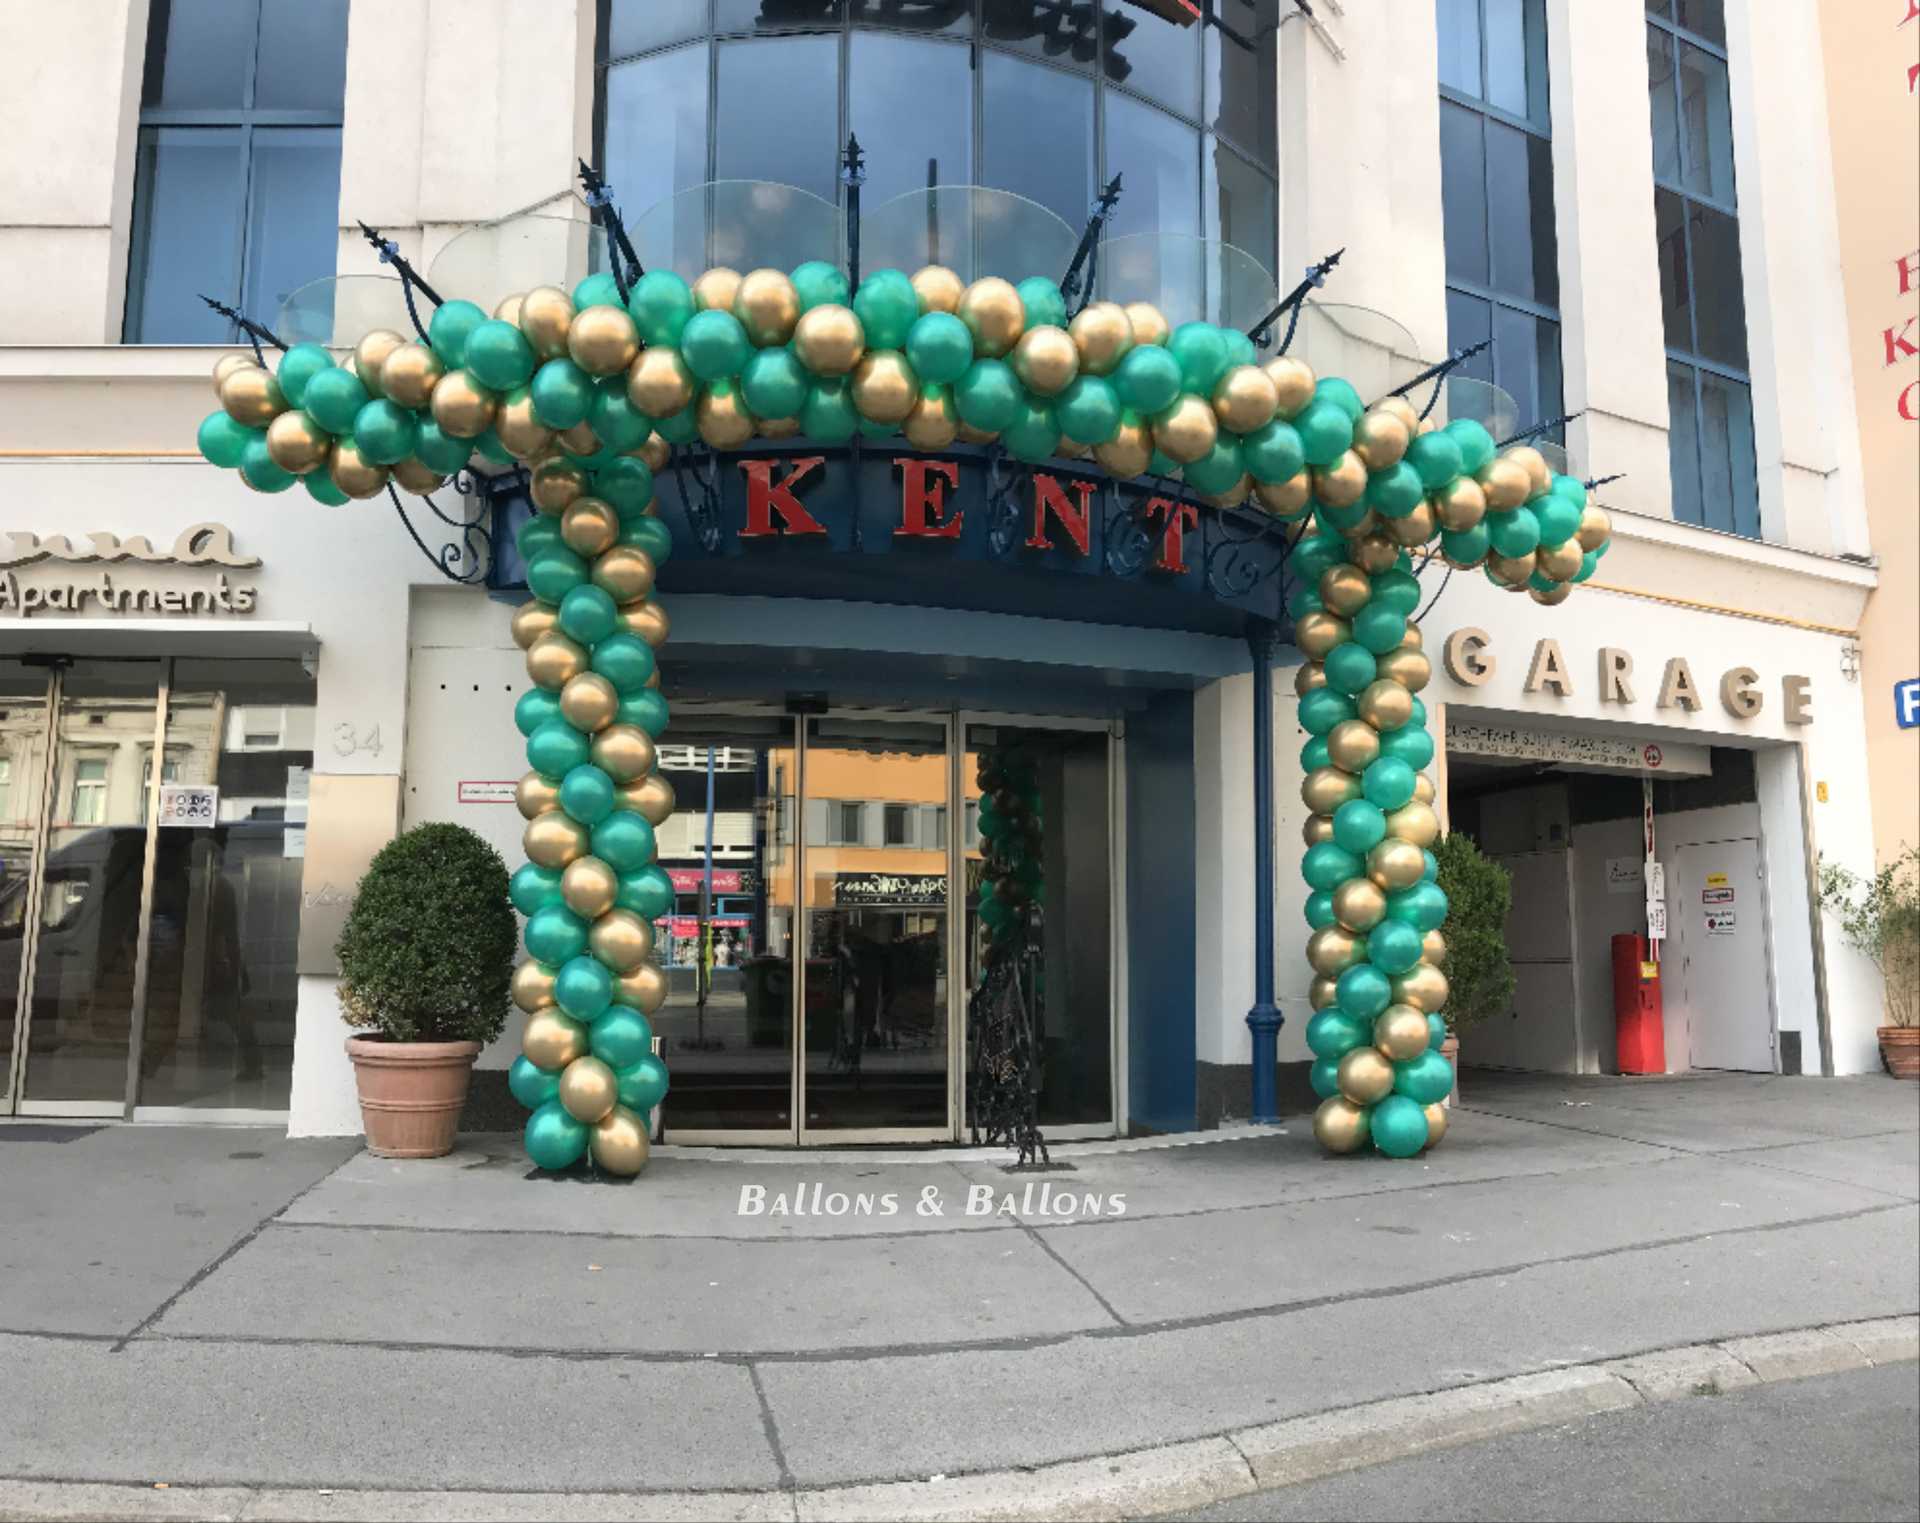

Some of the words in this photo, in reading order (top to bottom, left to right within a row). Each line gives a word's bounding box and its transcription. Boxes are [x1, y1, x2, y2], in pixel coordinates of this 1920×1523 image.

[737, 455, 1200, 574] KENT
[0, 570, 259, 618] Apartments
[1443, 626, 1813, 726] GARAGE
[333, 721, 384, 758] 34
